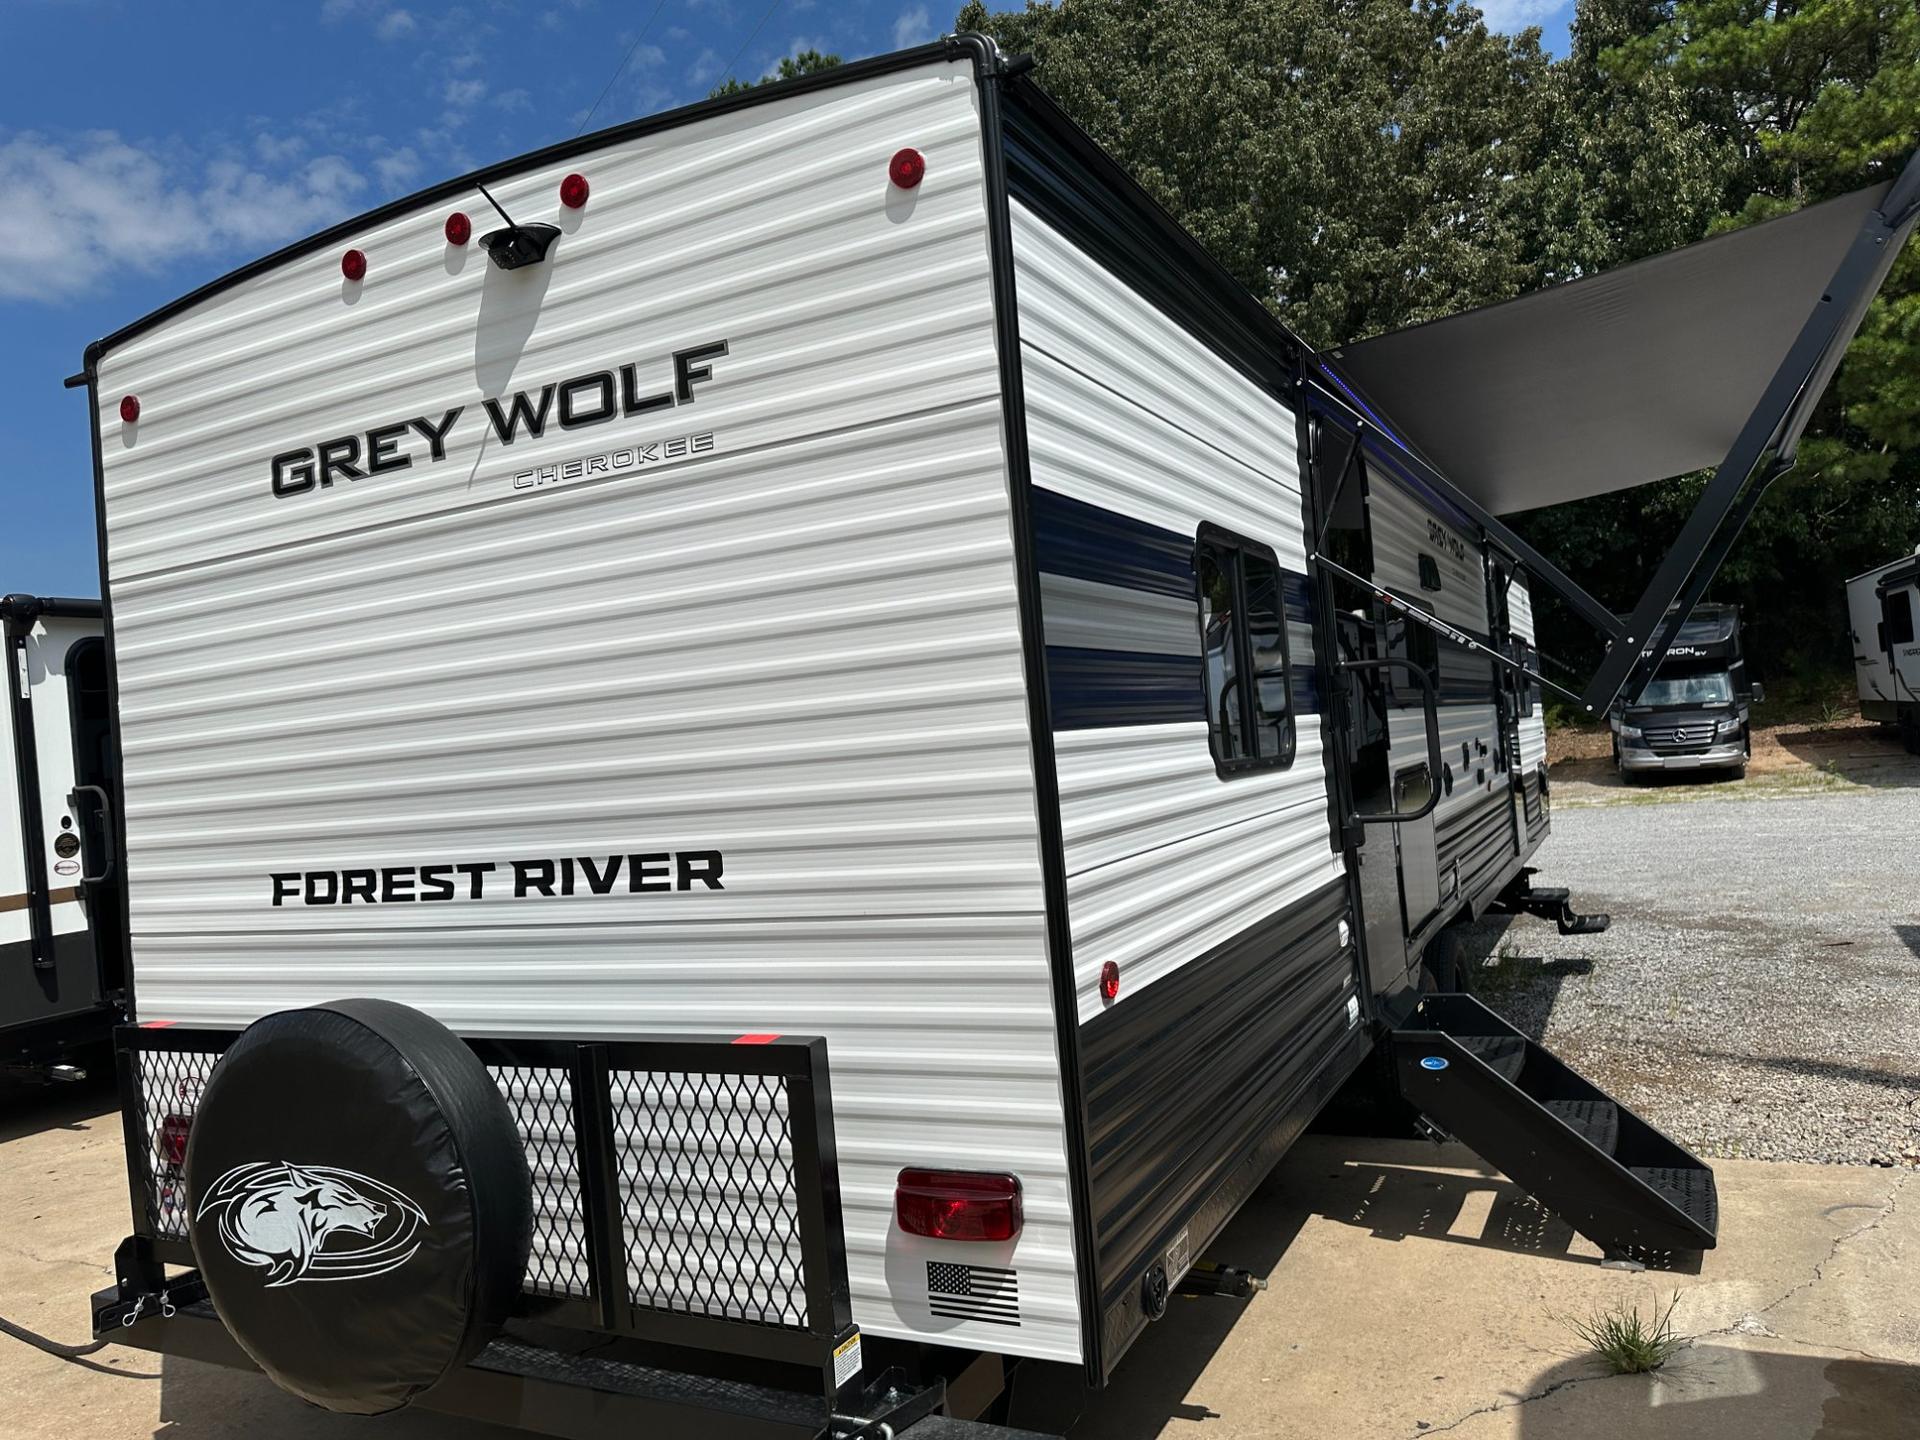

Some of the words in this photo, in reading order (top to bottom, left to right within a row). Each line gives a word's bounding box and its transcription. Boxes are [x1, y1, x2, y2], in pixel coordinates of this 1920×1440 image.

[271, 405, 465, 499] GREY
[481, 339, 729, 446] WOLF
[513, 431, 715, 490] CHEROKEE
[268, 861, 496, 906] FOREST
[508, 849, 726, 898] RIVER
